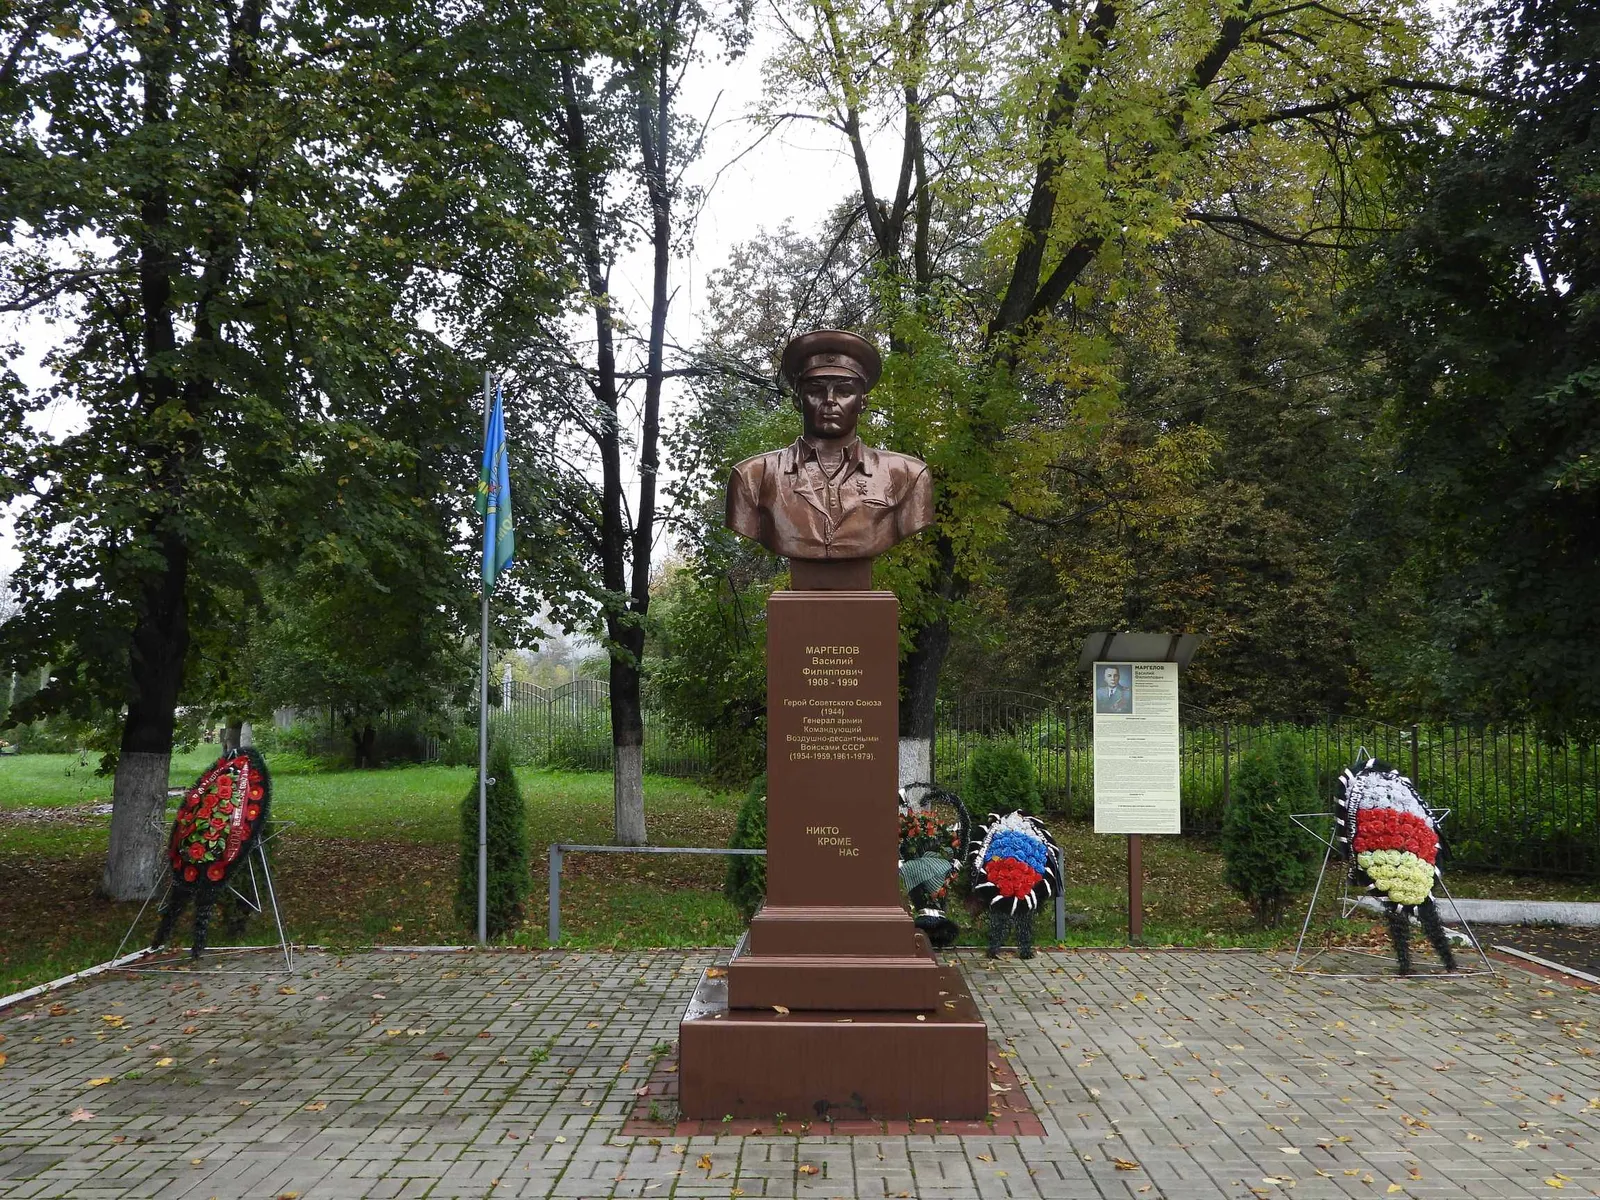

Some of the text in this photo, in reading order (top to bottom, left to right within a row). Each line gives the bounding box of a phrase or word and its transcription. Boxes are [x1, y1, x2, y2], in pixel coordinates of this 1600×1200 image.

[805, 646, 860, 655] МАРГЕЛОВ
[812, 657, 854, 665] Василий
[802, 667, 863, 676] Филиппович
[807, 678, 829, 686] 1908
[837, 678, 859, 686] 1990
[783, 699, 882, 708] Герой Советского Союза
[820, 708, 845, 717] (1944)
[803, 717, 835, 725] Генерал
[803, 725, 862, 735] Командующий
[786, 734, 879, 743] Воздушно-десантными
[800, 743, 865, 751] Войсками СССР
[806, 827, 840, 835] НИКТО
[817, 837, 852, 846] КРОМЕ
[839, 848, 860, 856] НАС
